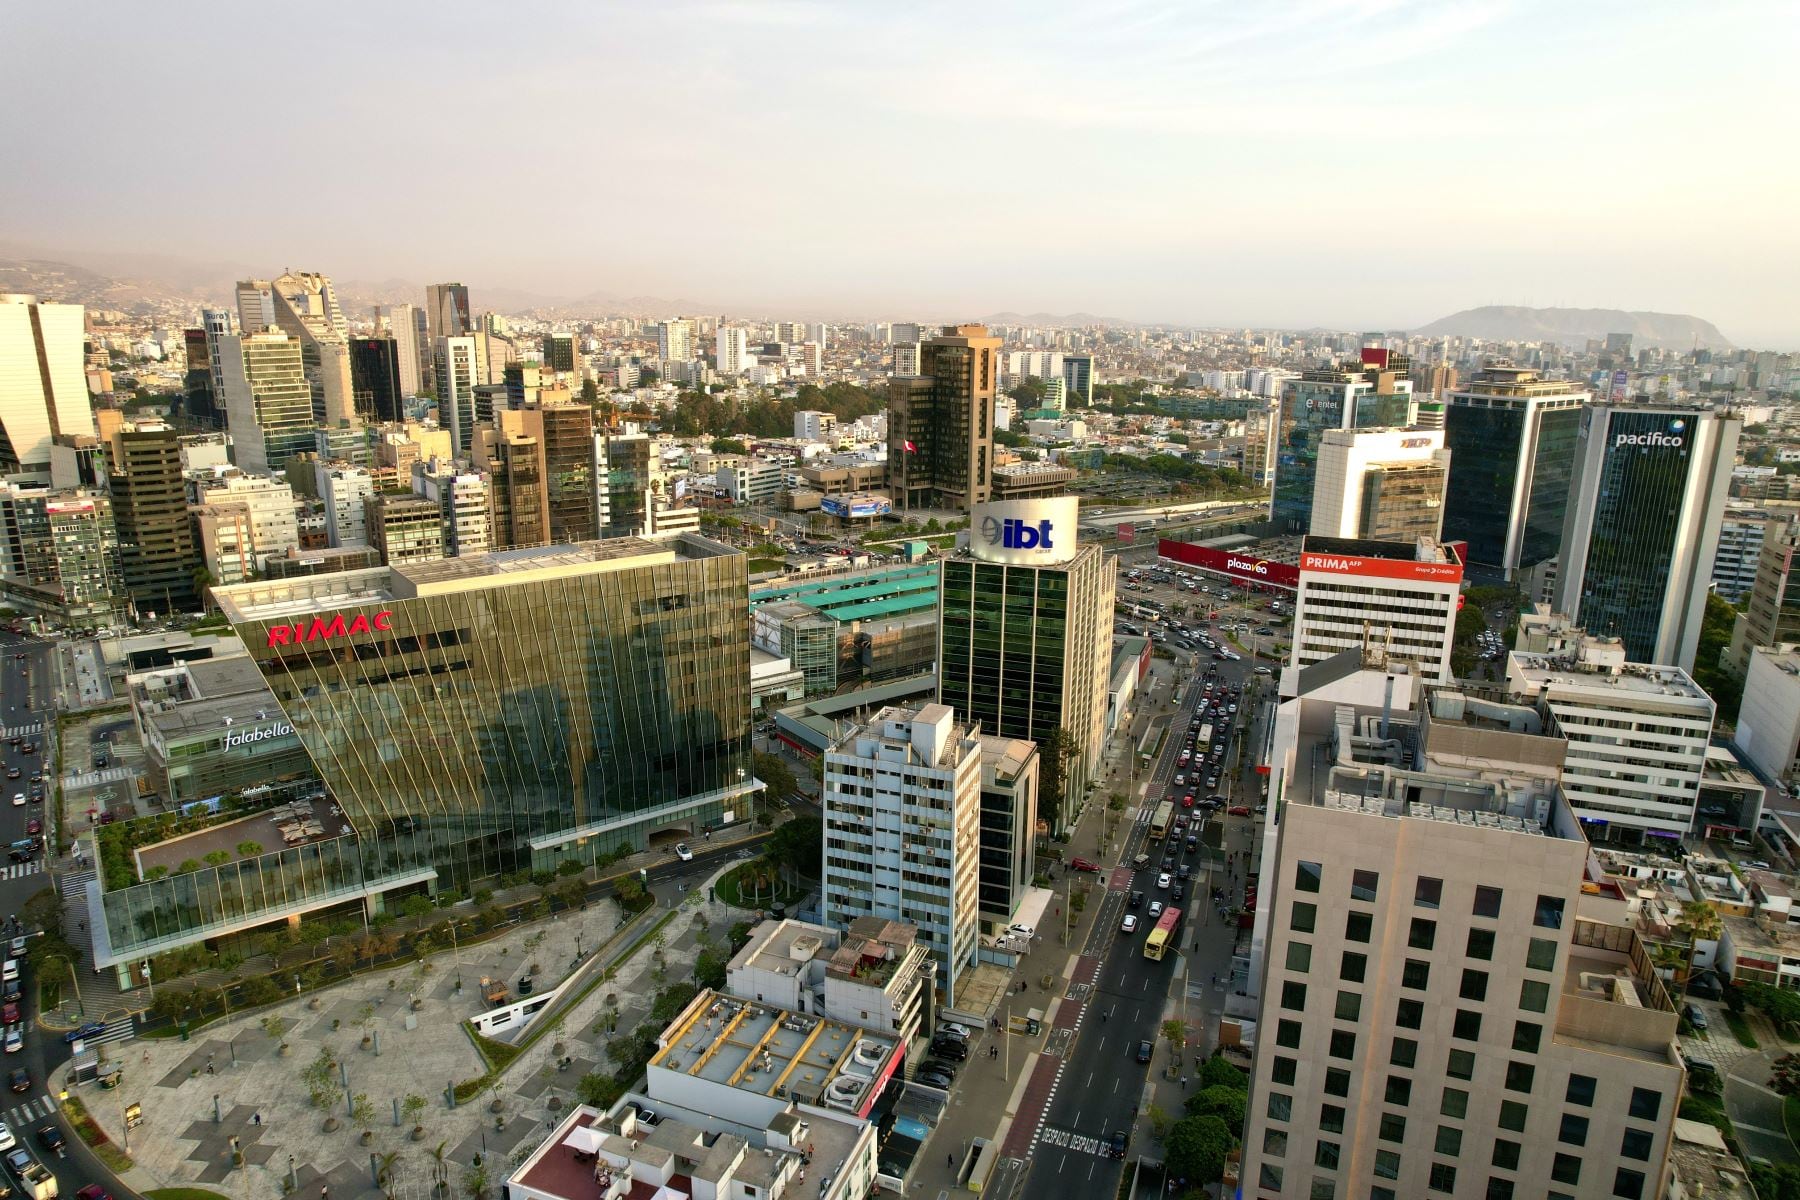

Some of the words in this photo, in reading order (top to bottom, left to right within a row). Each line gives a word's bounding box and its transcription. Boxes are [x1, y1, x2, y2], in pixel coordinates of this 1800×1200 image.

[1616, 431, 1683, 448] pacifico
[1003, 518, 1053, 549] ibt
[1306, 556, 1349, 571] PRIMA
[267, 610, 393, 648] RIMAC
[1041, 1127, 1070, 1147] DESPACIO
[1069, 1134, 1099, 1155] DESPACIO
